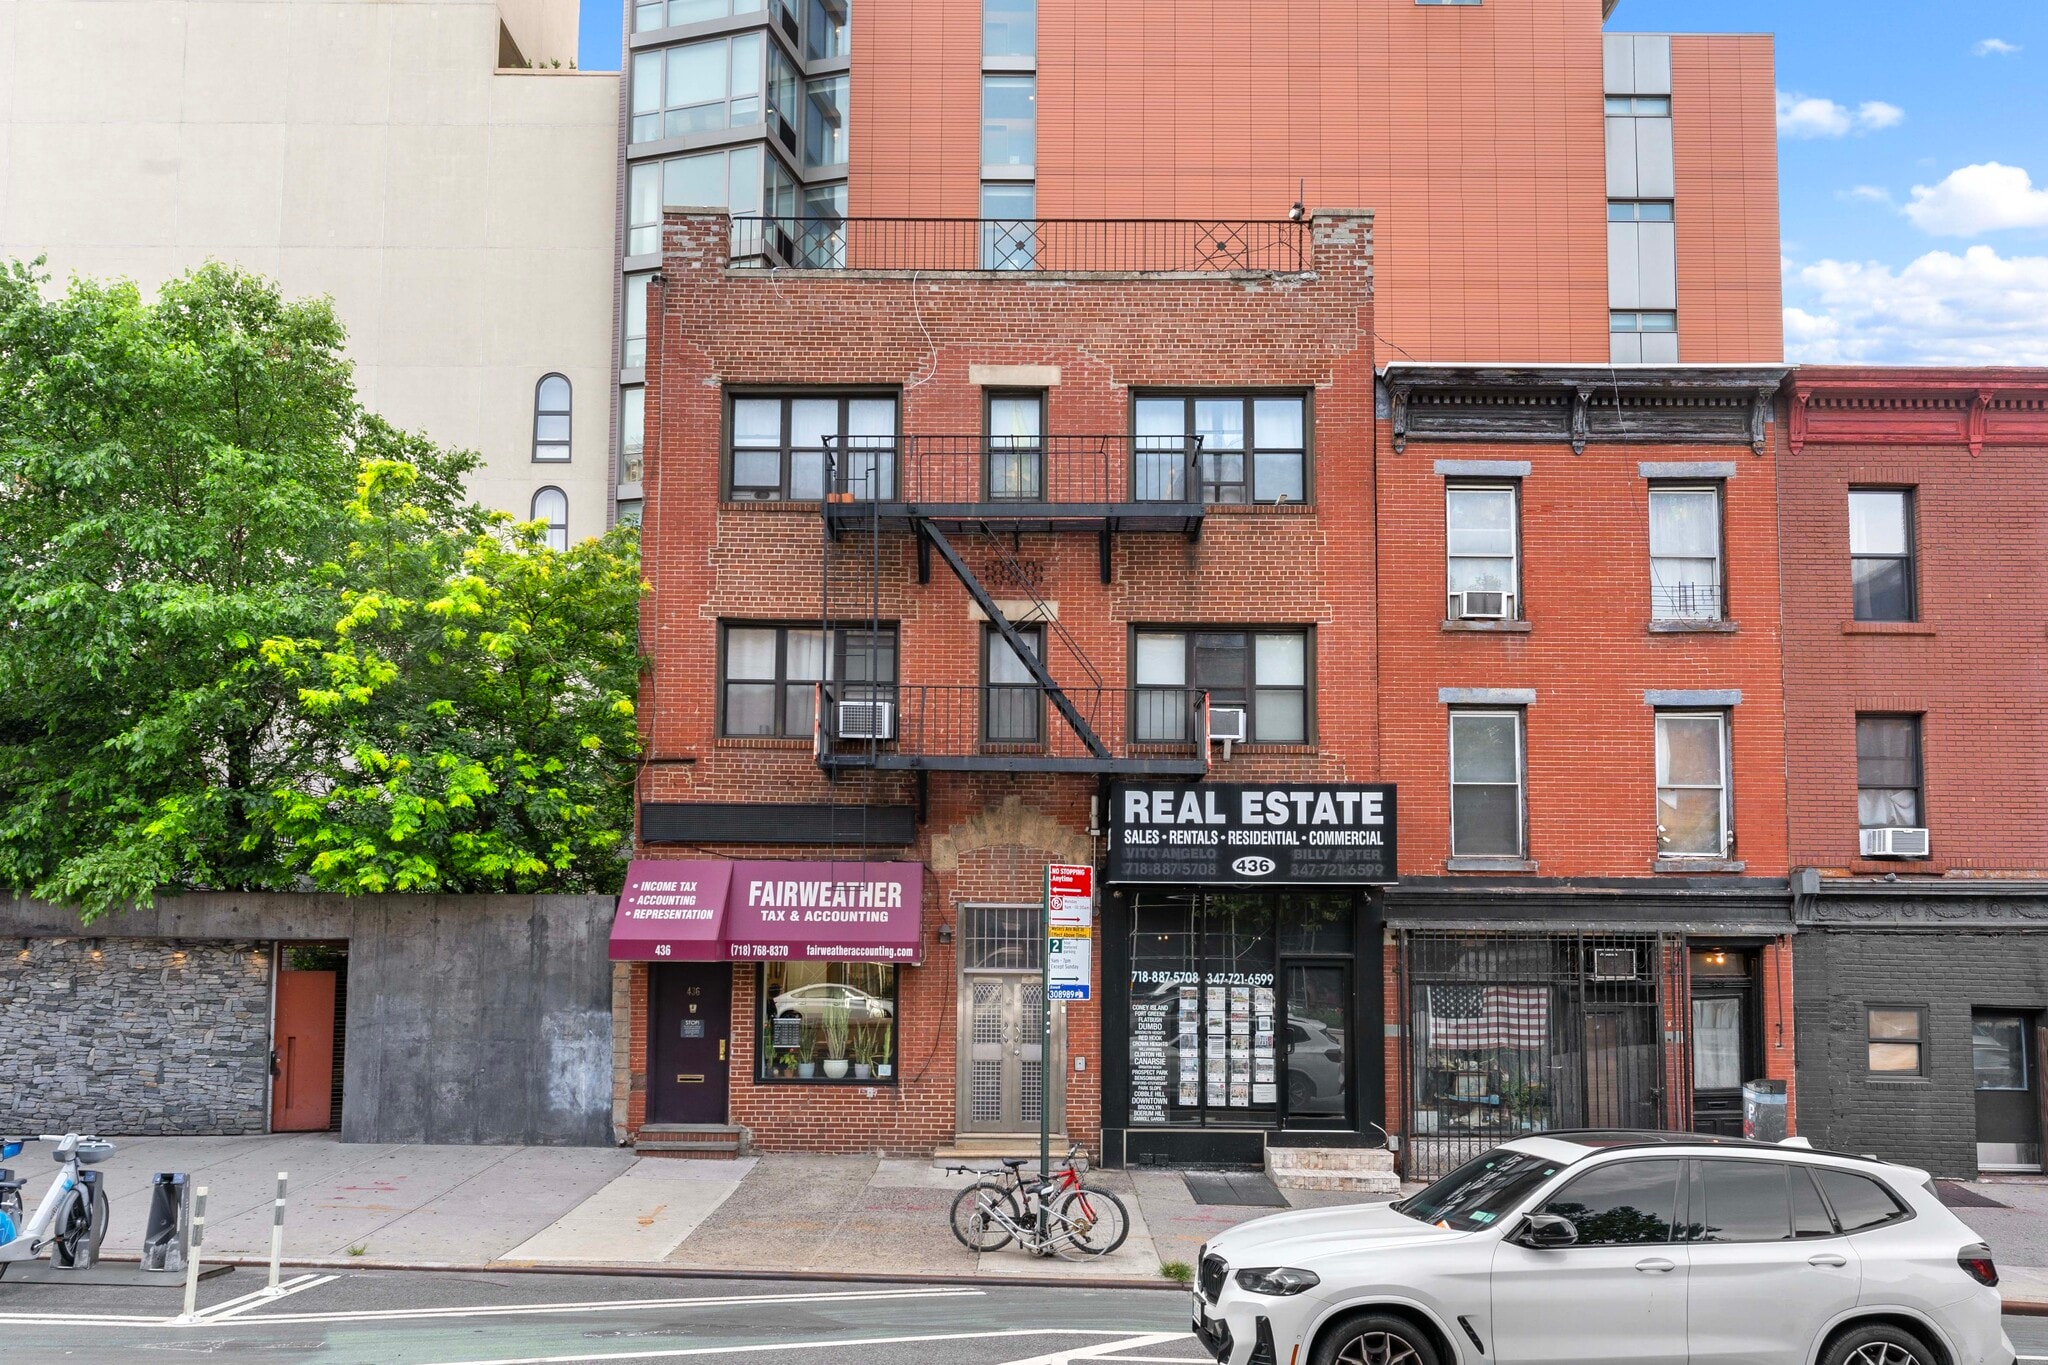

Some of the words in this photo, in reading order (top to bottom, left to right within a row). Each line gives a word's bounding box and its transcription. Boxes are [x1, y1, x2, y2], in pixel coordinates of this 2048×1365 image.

[1125, 791, 1226, 824] REAL
[1241, 791, 1384, 824] ESTATE
[1124, 830, 1160, 845] SALES
[1169, 831, 1218, 845] RENTALS
[1228, 831, 1300, 846] RESIDENTIAL
[1309, 831, 1384, 846] COMMERCIAL
[1060, 868, 1086, 876] STOPPING
[1236, 859, 1270, 872] 436
[1052, 875, 1074, 883] Anytime
[641, 881, 677, 892] INCOME
[679, 882, 697, 892] TAX
[637, 895, 696, 905] ACCOUNTING
[749, 880, 902, 908] FAIRWEATHER
[633, 909, 714, 920] REPRESENTATION
[761, 910, 785, 922] TAX
[789, 910, 800, 922] &
[804, 910, 889, 923] ACCOUNTING
[655, 944, 671, 956] 436
[730, 944, 751, 957] (718)
[752, 945, 789, 957] 768-8370
[806, 945, 914, 958] fairweatheraccounting.com
[1052, 940, 1060, 953] 2
[1132, 971, 1199, 984] 718-887-5708
[1207, 973, 1274, 986] 347-721-6599
[687, 986, 701, 997] 436
[1138, 1023, 1163, 1031] DUMBO
